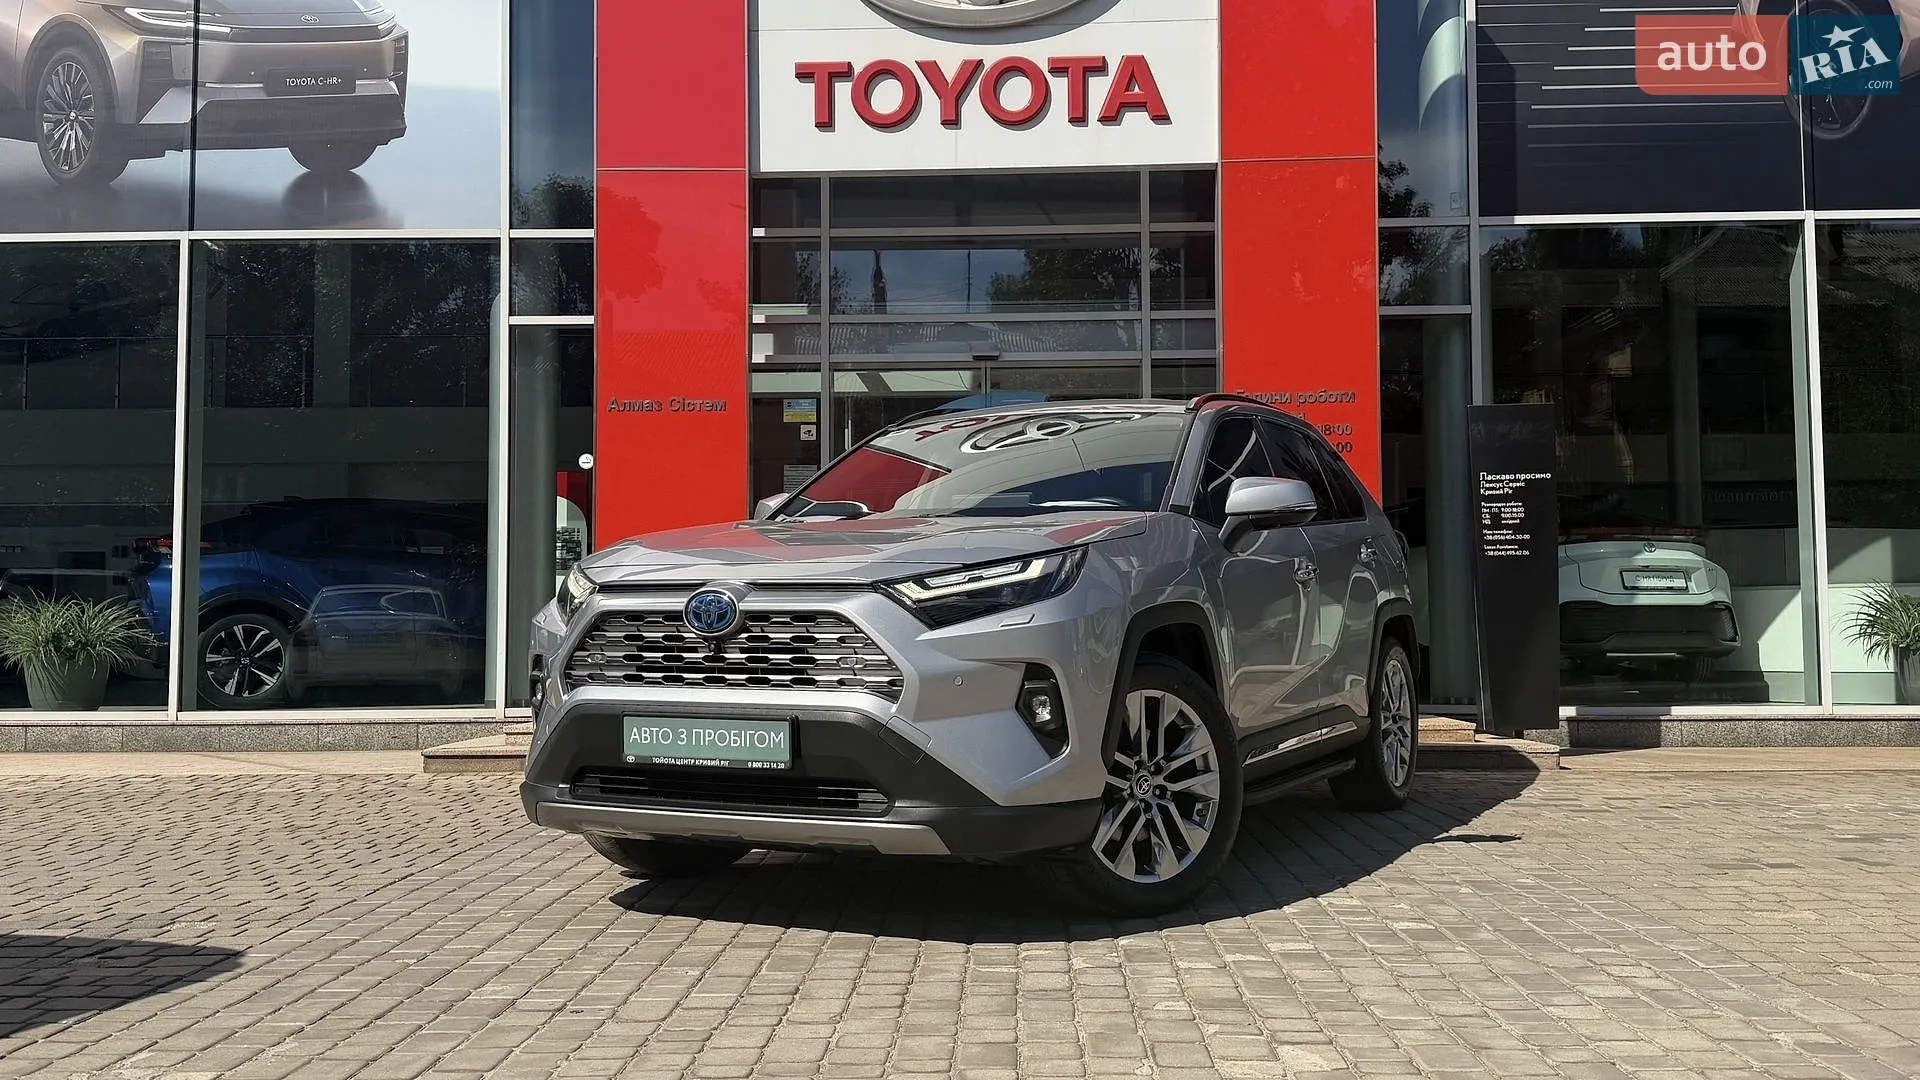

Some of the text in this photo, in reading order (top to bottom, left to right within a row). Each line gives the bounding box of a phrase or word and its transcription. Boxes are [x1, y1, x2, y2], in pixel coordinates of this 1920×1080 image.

[285, 77, 342, 86] TOYOTA C-HR+
[795, 54, 1172, 131] TOYOTA
[607, 396, 727, 413] Алмаз Сістем
[1297, 389, 1356, 407] роботи
[1480, 472, 1515, 480] Ласкаво
[629, 726, 785, 749] АВТО З ПРОБІГОМ
[651, 756, 675, 764] ТОЙОТА
[676, 758, 695, 766] ЦЕНТР
[695, 758, 720, 766] КРИВИЙ
